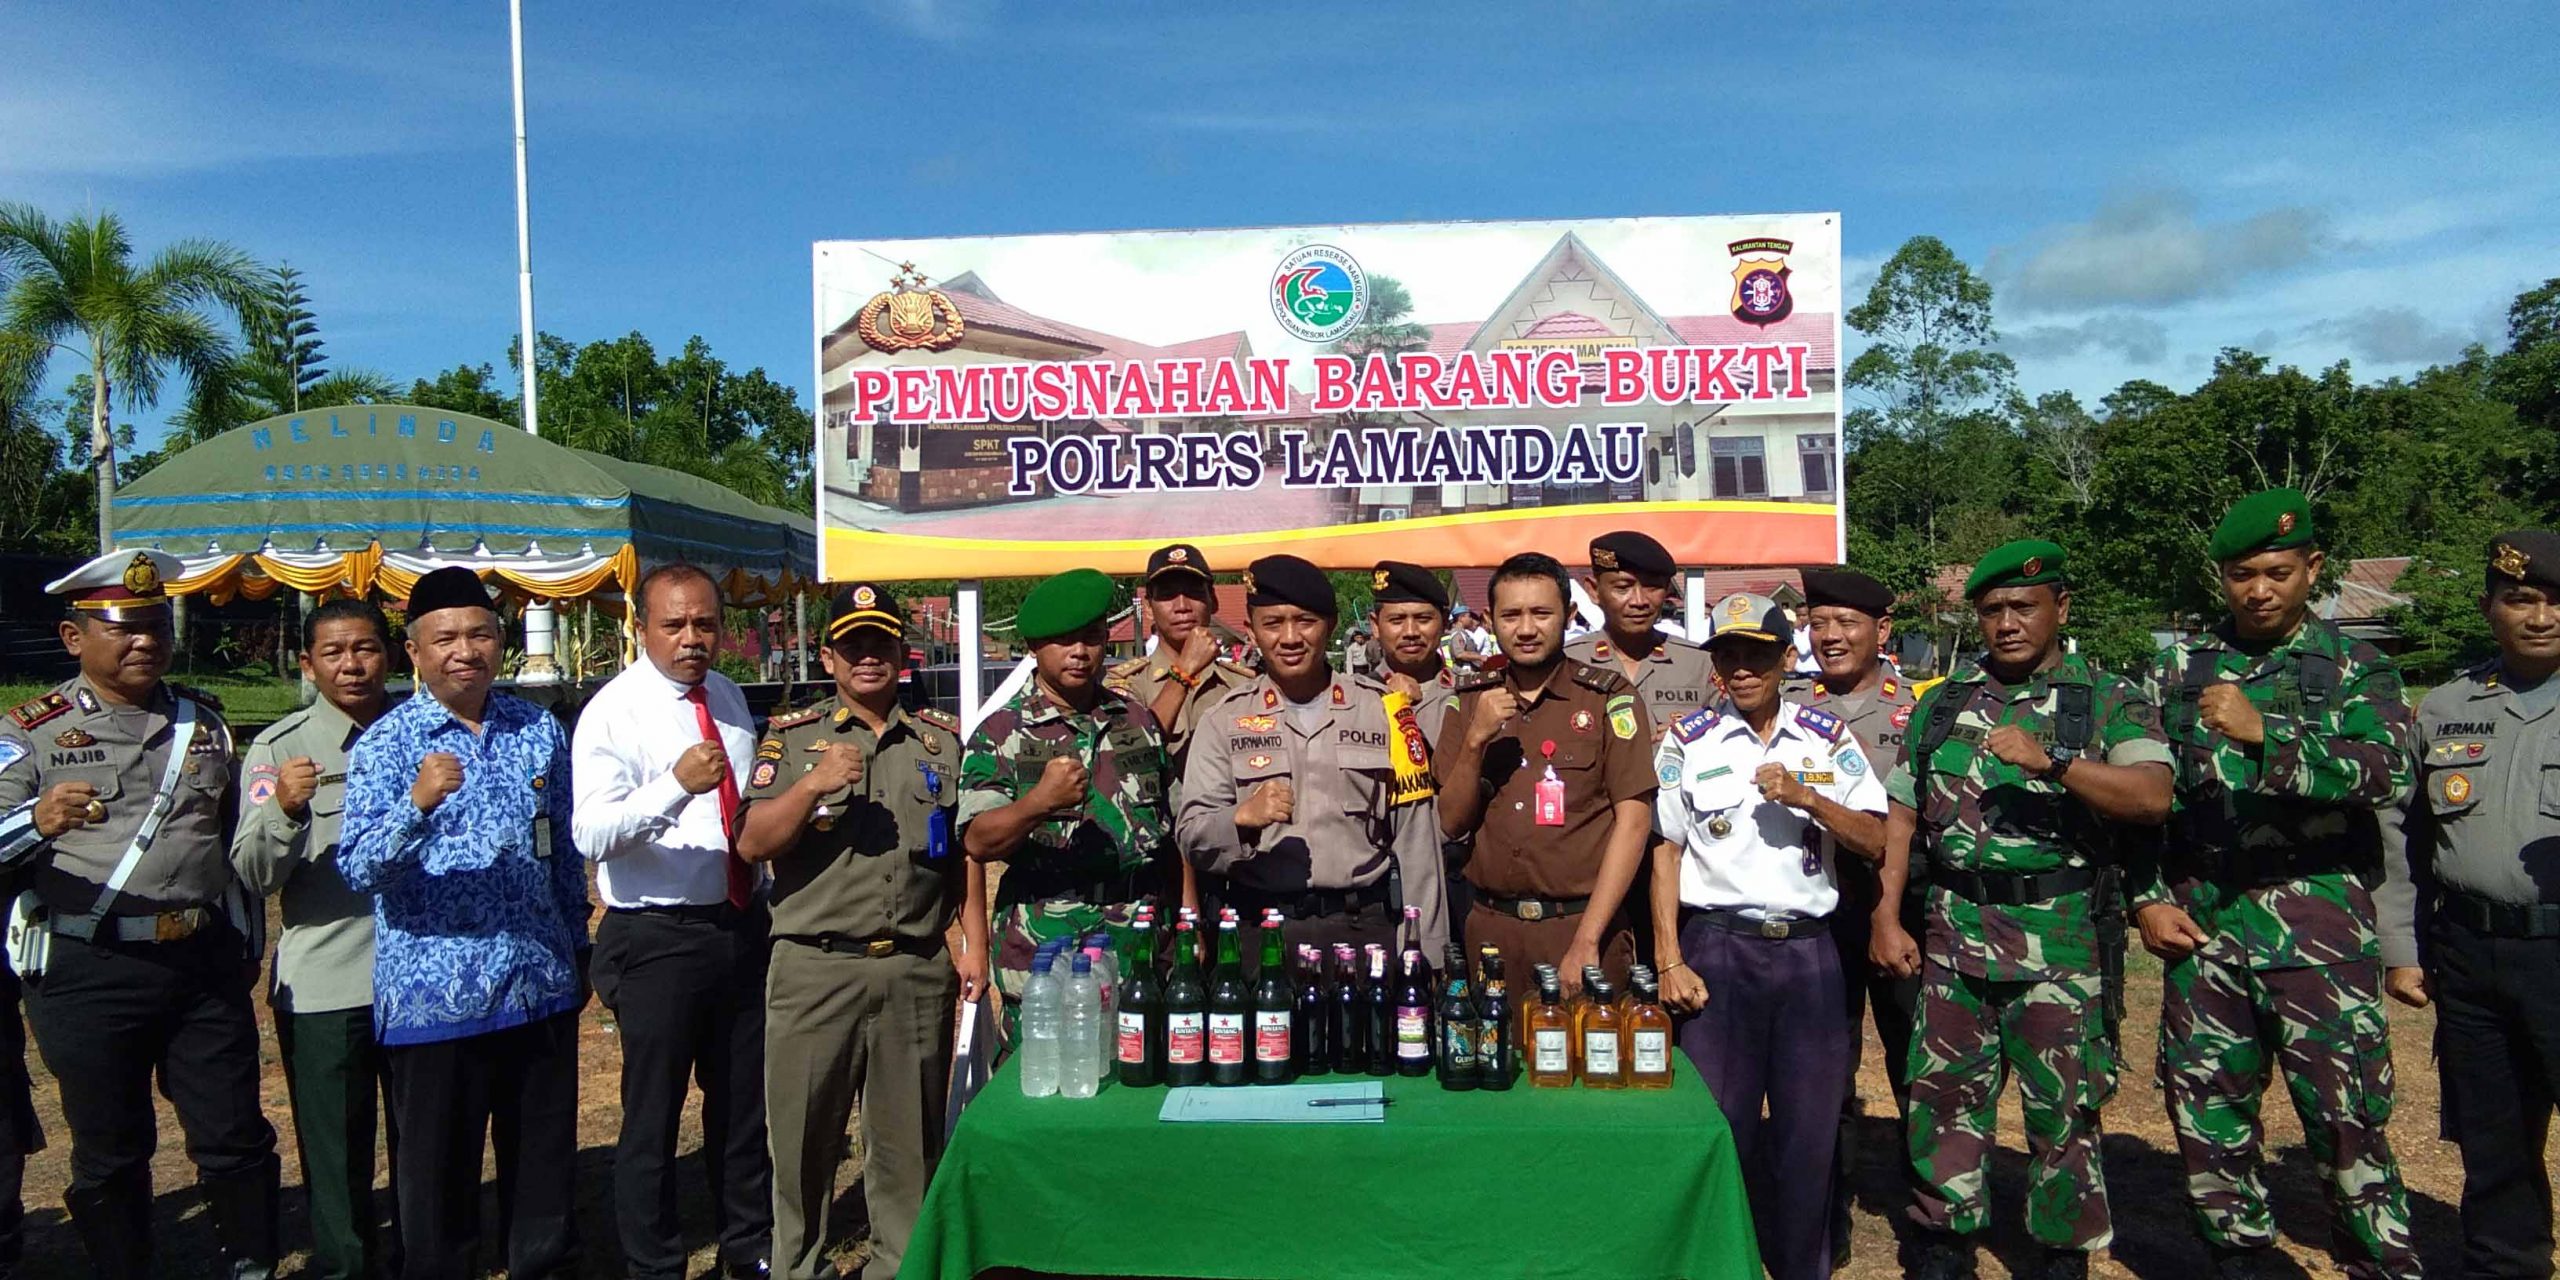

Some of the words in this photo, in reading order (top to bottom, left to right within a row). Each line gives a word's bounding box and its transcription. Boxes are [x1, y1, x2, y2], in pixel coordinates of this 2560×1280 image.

[1732, 242, 1766, 252] KALIMANTAN
[1767, 242, 1789, 251] TENGAH
[1284, 250, 1312, 271] SATUAN
[1314, 249, 1348, 266] RESERSE
[1347, 264, 1362, 302] NARKOBA
[1275, 298, 1301, 333] KEPOLISIAN
[1301, 329, 1325, 338] RESOR
[1326, 311, 1358, 338] LAMANDAU
[853, 358, 1290, 421] PEMUSNAHAN
[1314, 351, 1582, 410] BARANG
[1603, 345, 1811, 403] BUKTI
[973, 439, 1001, 451] SPKT
[1009, 435, 1261, 495] POLRES
[1284, 426, 1645, 486] LAMANDAU
[1655, 690, 1698, 702] POLRI
[1339, 729, 1386, 746] POLRI
[2436, 722, 2496, 737] HERMAN
[1231, 735, 1282, 751] PURWANTO
[1879, 734, 1902, 746] PO
[50, 749, 106, 767] NAJIB
